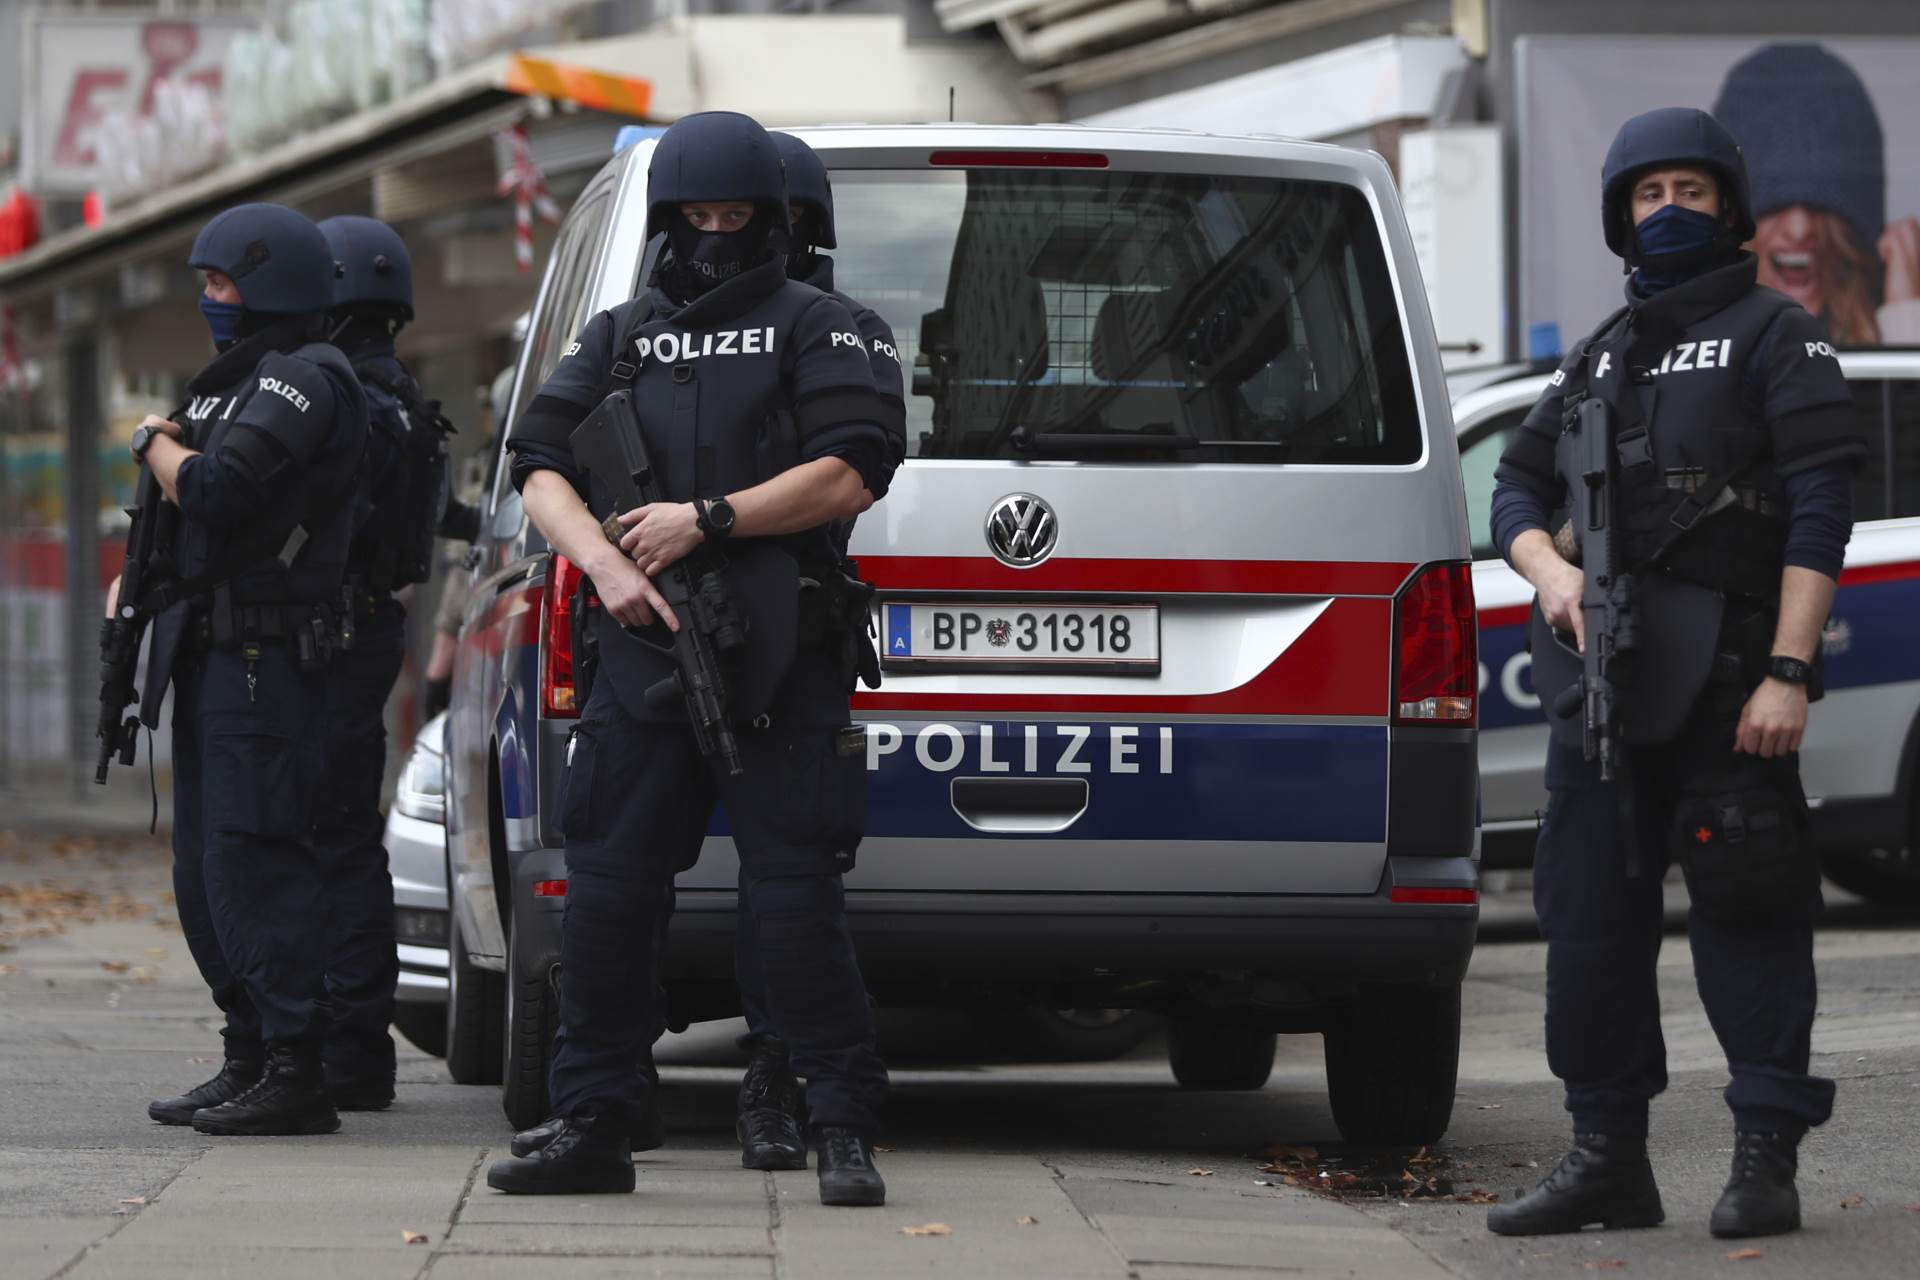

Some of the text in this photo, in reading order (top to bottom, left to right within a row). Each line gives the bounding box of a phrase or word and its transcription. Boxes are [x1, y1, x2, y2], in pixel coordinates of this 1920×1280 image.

[635, 326, 775, 368] POLIZEI
[259, 377, 311, 413] POLIZEI
[894, 637, 907, 650] A
[932, 612, 1132, 653] BP 31318
[866, 723, 1174, 775] POLIZEI
